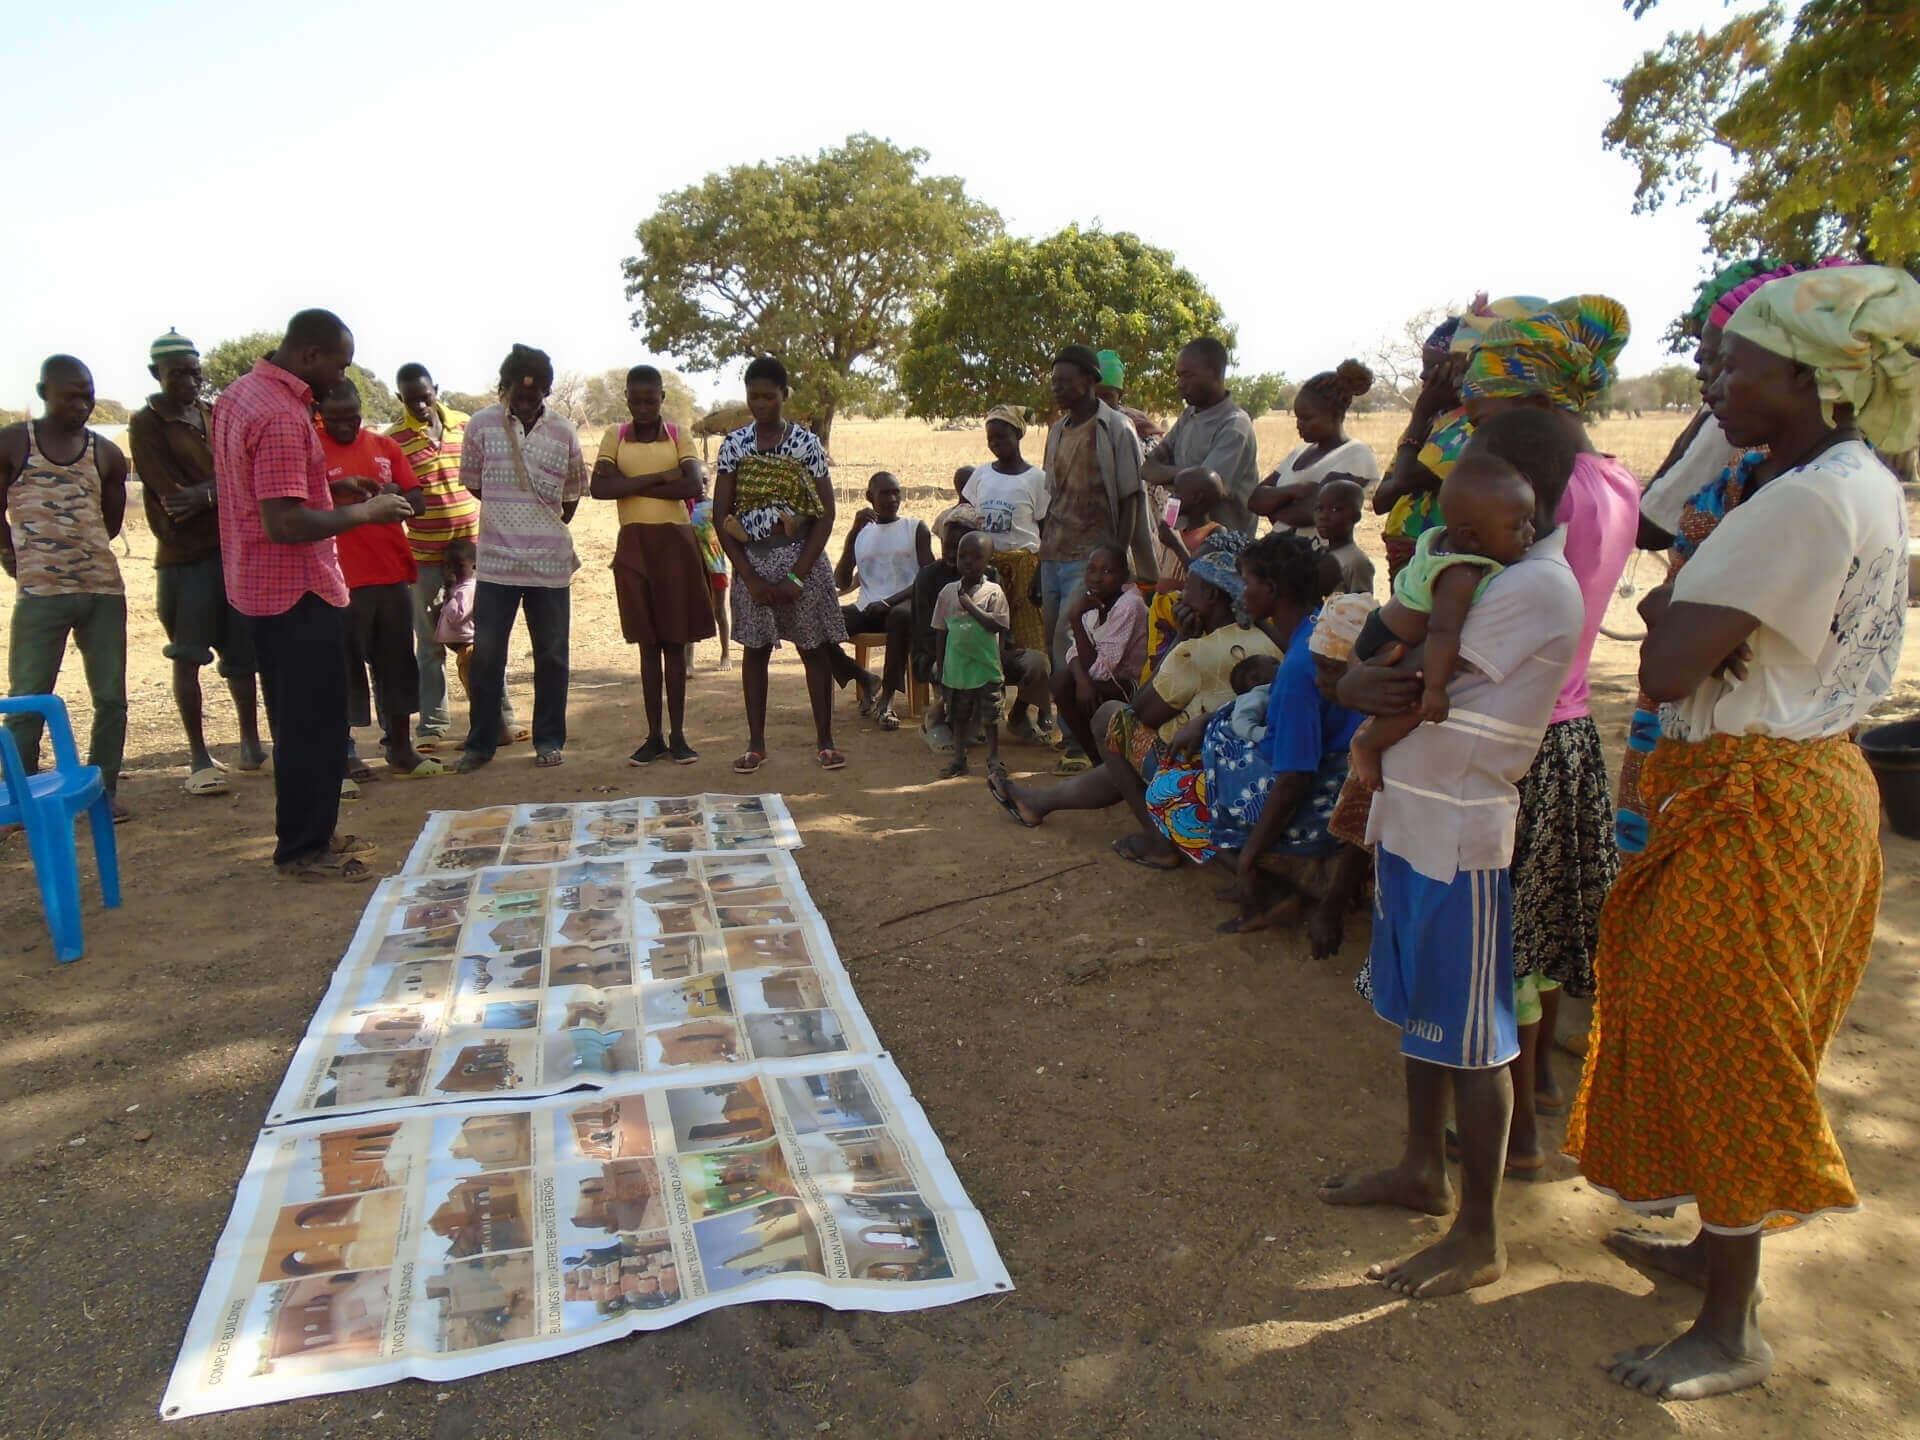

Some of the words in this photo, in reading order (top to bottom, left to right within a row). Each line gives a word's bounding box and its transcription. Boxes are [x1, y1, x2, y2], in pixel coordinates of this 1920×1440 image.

[833, 1245, 848, 1279] NUBIAN
[548, 1290, 561, 1335] BUILDINGS
[207, 1340, 230, 1385] COMPLEX
[222, 1298, 246, 1340] BUILDINGS
